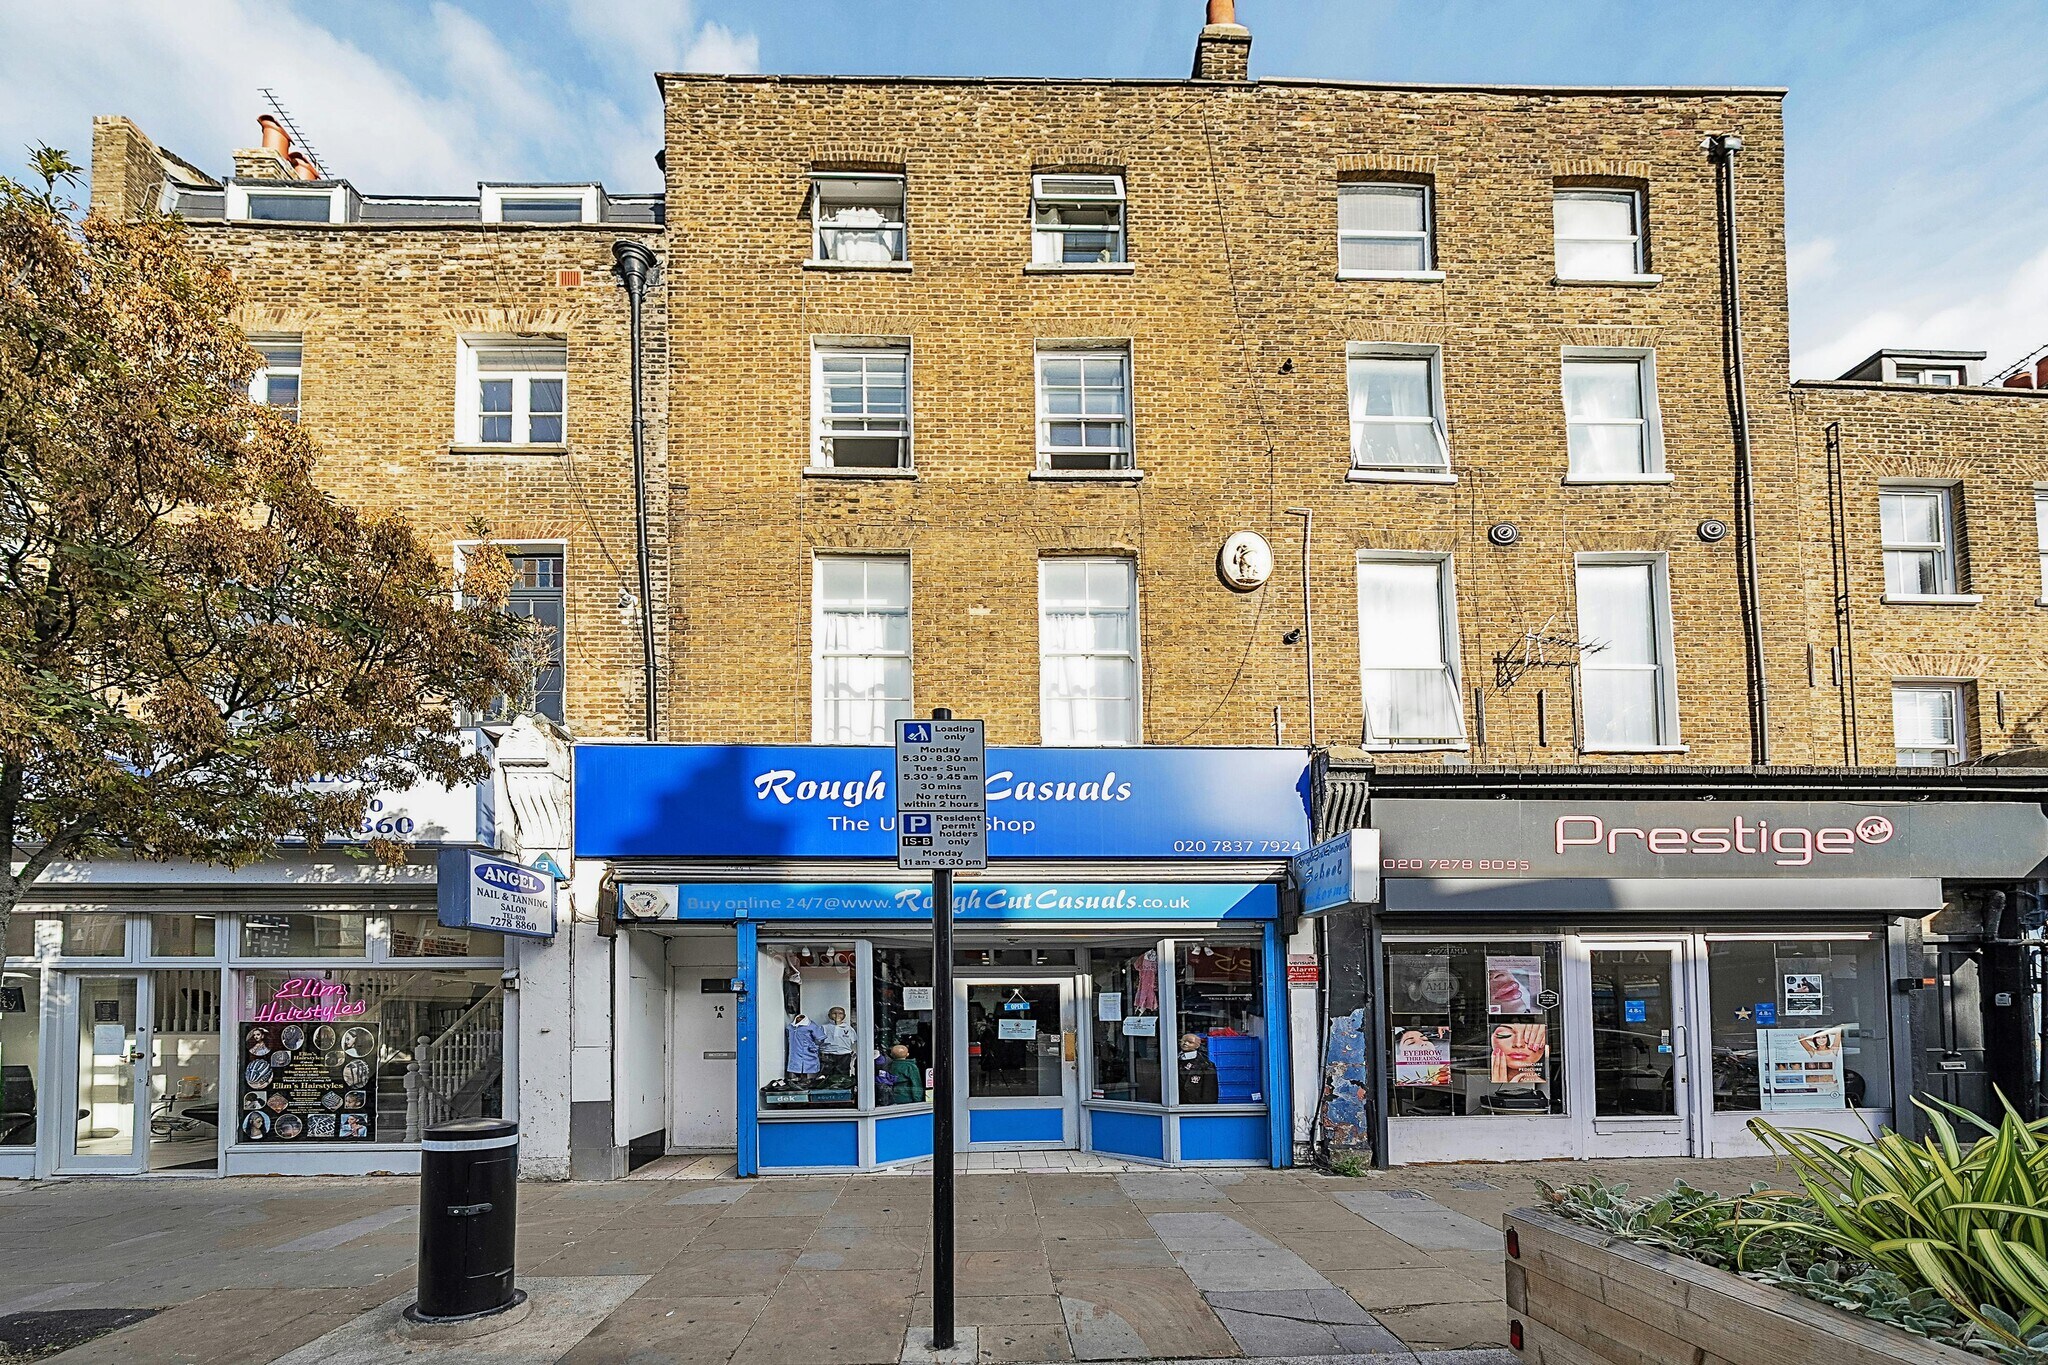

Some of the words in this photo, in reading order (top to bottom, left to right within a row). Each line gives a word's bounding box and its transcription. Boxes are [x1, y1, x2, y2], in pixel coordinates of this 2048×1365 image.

[920, 746, 960, 754] Monday
[754, 769, 886, 808] Rough
[985, 771, 1132, 801] Casuals
[828, 816, 870, 831] The
[910, 816, 926, 832] P
[904, 837, 931, 845] IS-B
[948, 838, 970, 846] only
[1174, 840, 1206, 852] 020
[1211, 840, 1254, 852] 7837
[1260, 840, 1302, 852] 7924
[1555, 815, 1855, 867] Prestige
[1305, 858, 1342, 885] School
[1382, 859, 1423, 870] 020
[1429, 859, 1474, 870] 7278
[1479, 860, 1530, 870] 8095
[484, 866, 537, 890] ANGEL
[476, 887, 500, 900] NAIL
[502, 892, 509, 902] &
[511, 894, 548, 908] TANNING
[630, 892, 658, 900] DIAMOND
[500, 903, 527, 914] SALON
[688, 898, 720, 912] Buy
[725, 896, 781, 910] online
[490, 916, 512, 928] 7278
[516, 921, 537, 931] 8860
[275, 978, 346, 998] Elim
[254, 998, 366, 1022] Hairstyles
[300, 1082, 344, 1090] Hairstyles
